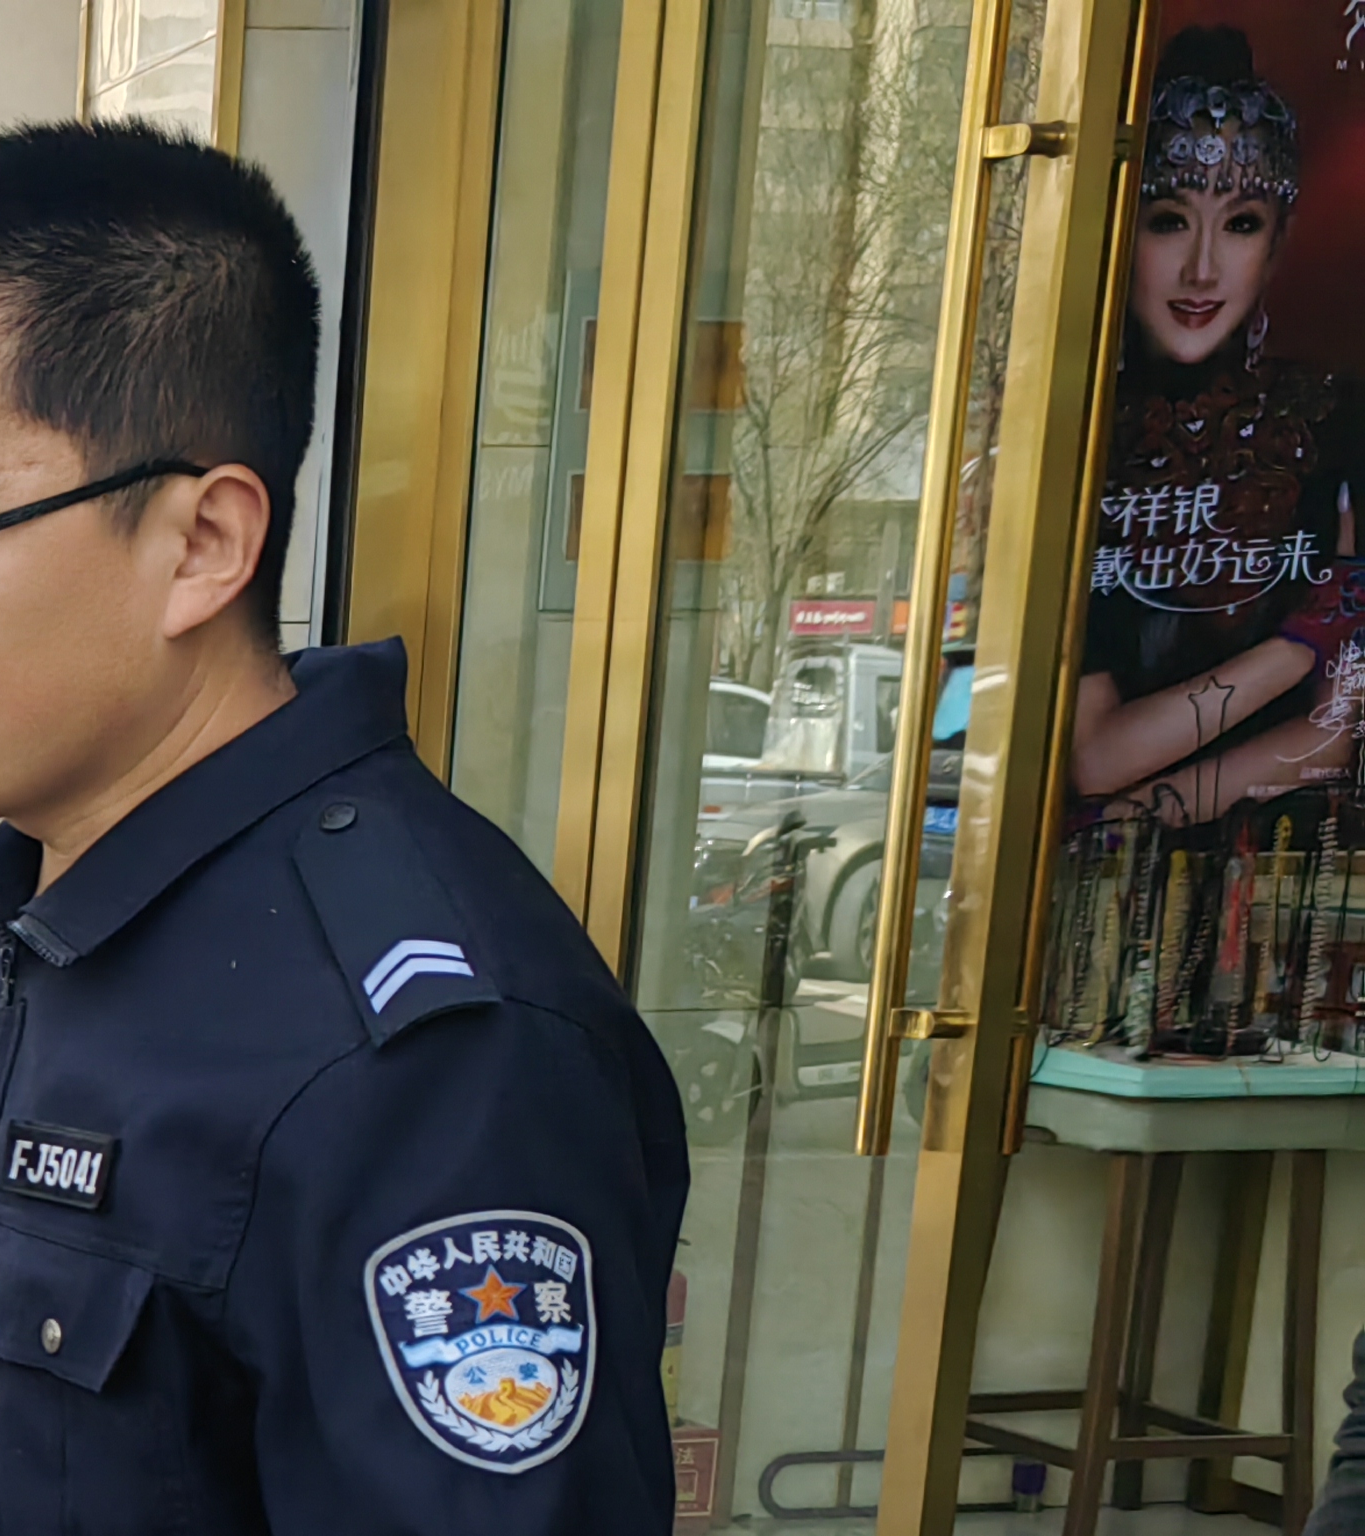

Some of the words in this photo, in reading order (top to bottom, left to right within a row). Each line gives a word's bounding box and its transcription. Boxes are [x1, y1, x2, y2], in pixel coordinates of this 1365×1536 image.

[1100, 484, 1236, 538] 祥银
[1089, 529, 1333, 606] 戴出好运来
[8, 1139, 103, 1195] FJ5041
[379, 1230, 577, 1297] 中华人民共和国
[404, 1289, 453, 1337] 警
[534, 1280, 571, 1323] 察
[456, 1326, 542, 1356] POLICE
